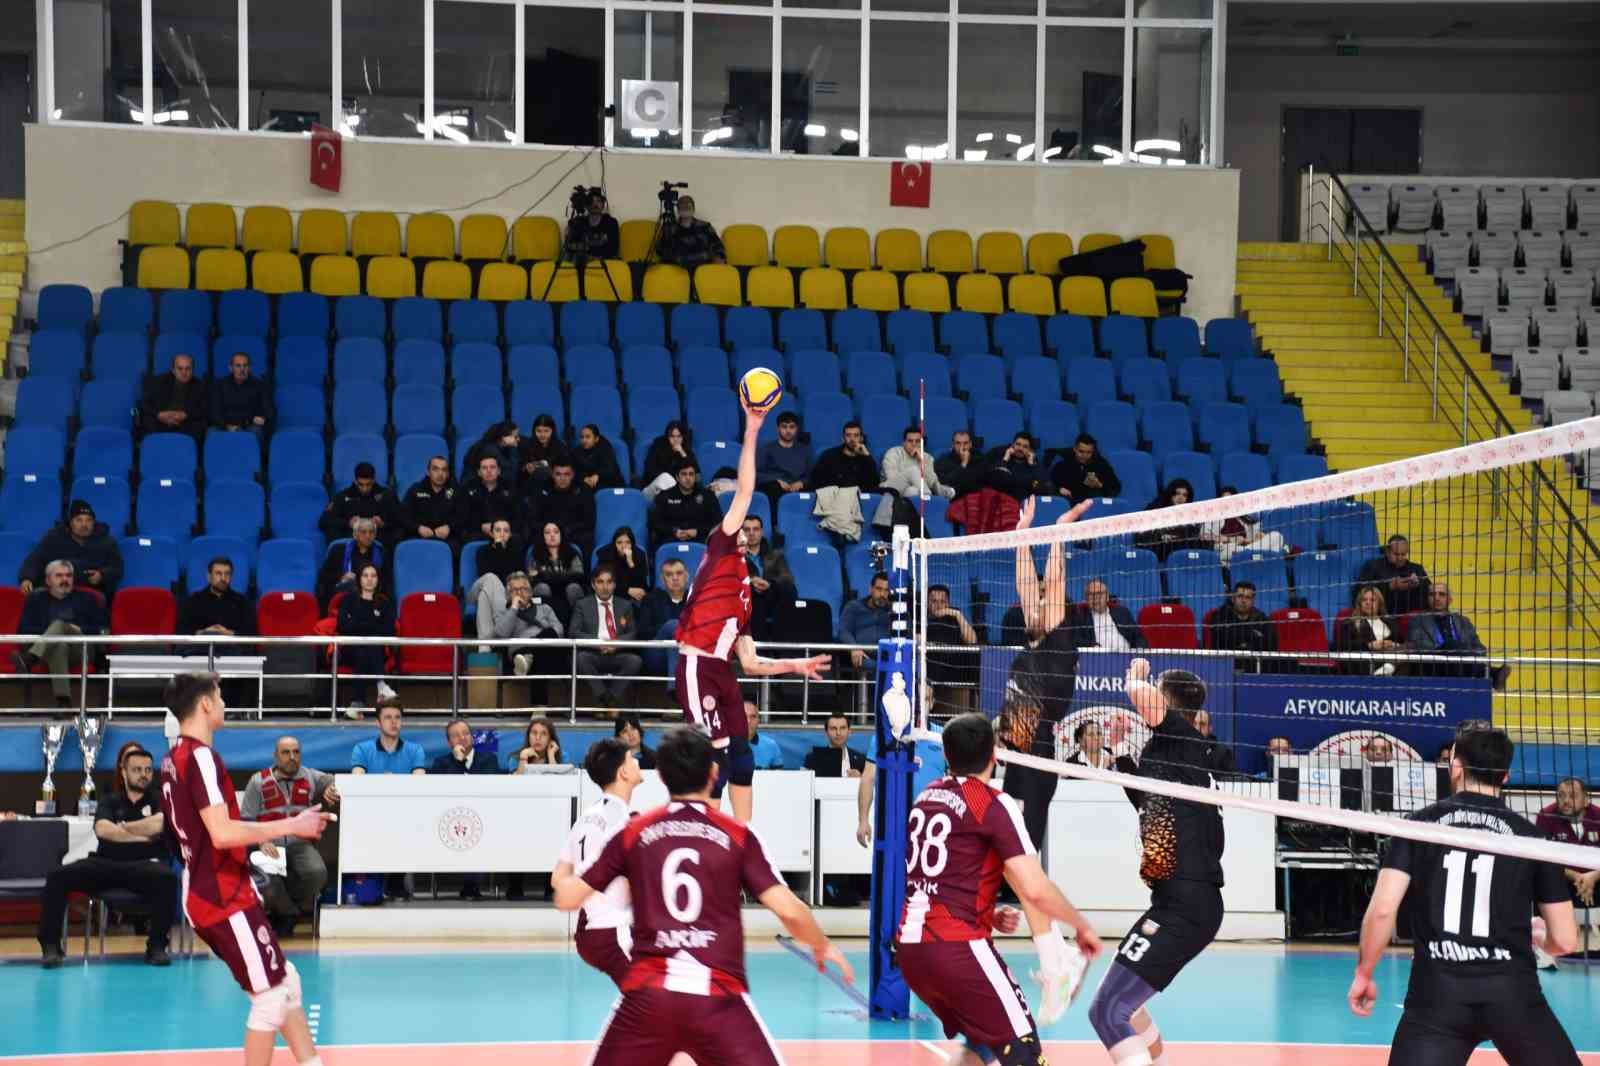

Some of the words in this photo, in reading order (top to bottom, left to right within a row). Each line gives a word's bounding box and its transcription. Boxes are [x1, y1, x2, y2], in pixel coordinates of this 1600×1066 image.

[634, 89, 666, 122] C
[704, 710, 721, 732] 14
[1284, 697, 1447, 718] AFYONKARAHİSAR
[906, 808, 952, 877] 38
[661, 847, 703, 923] 6
[1442, 850, 1495, 938] 11
[265, 945, 279, 971] 2
[1120, 932, 1151, 962] 13
